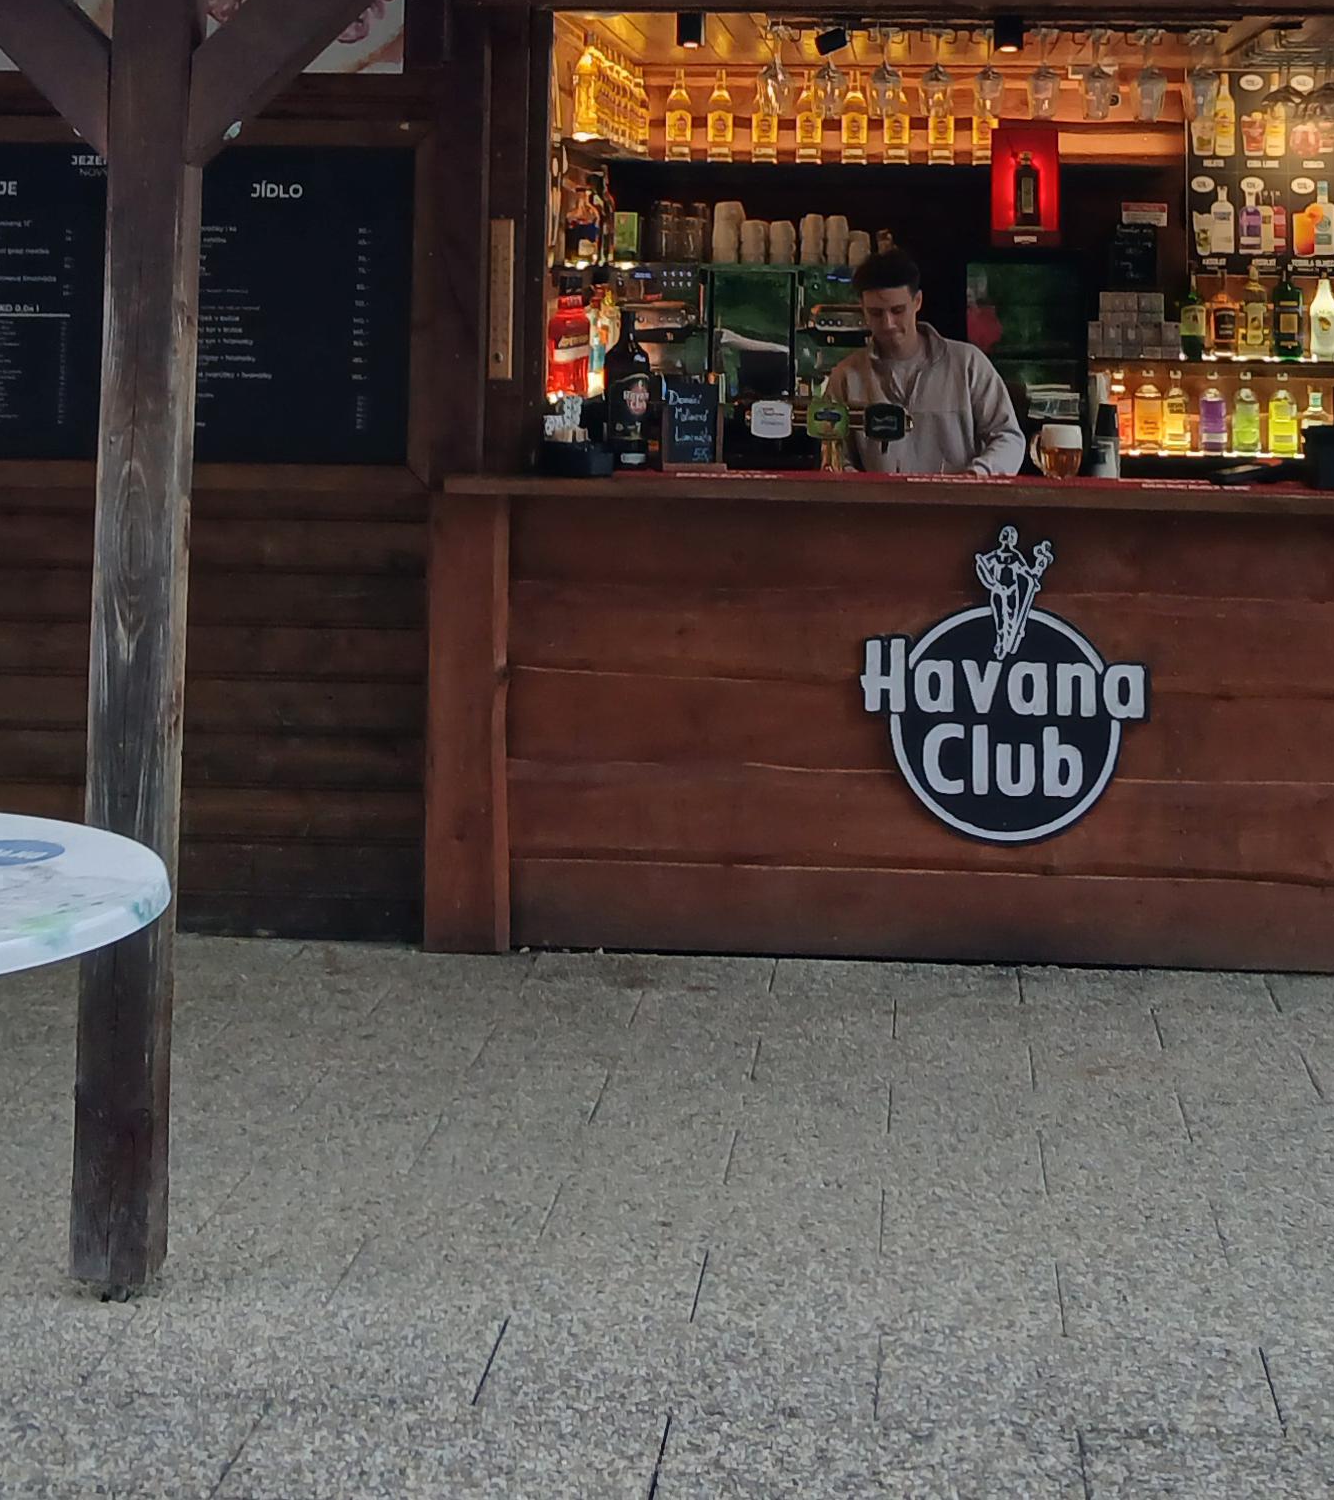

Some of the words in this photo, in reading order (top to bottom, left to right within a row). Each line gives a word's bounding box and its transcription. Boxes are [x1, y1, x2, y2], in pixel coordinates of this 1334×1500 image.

[250, 179, 303, 199] JÍDLO
[860, 638, 1145, 718] Havana
[922, 722, 1083, 797] Club
